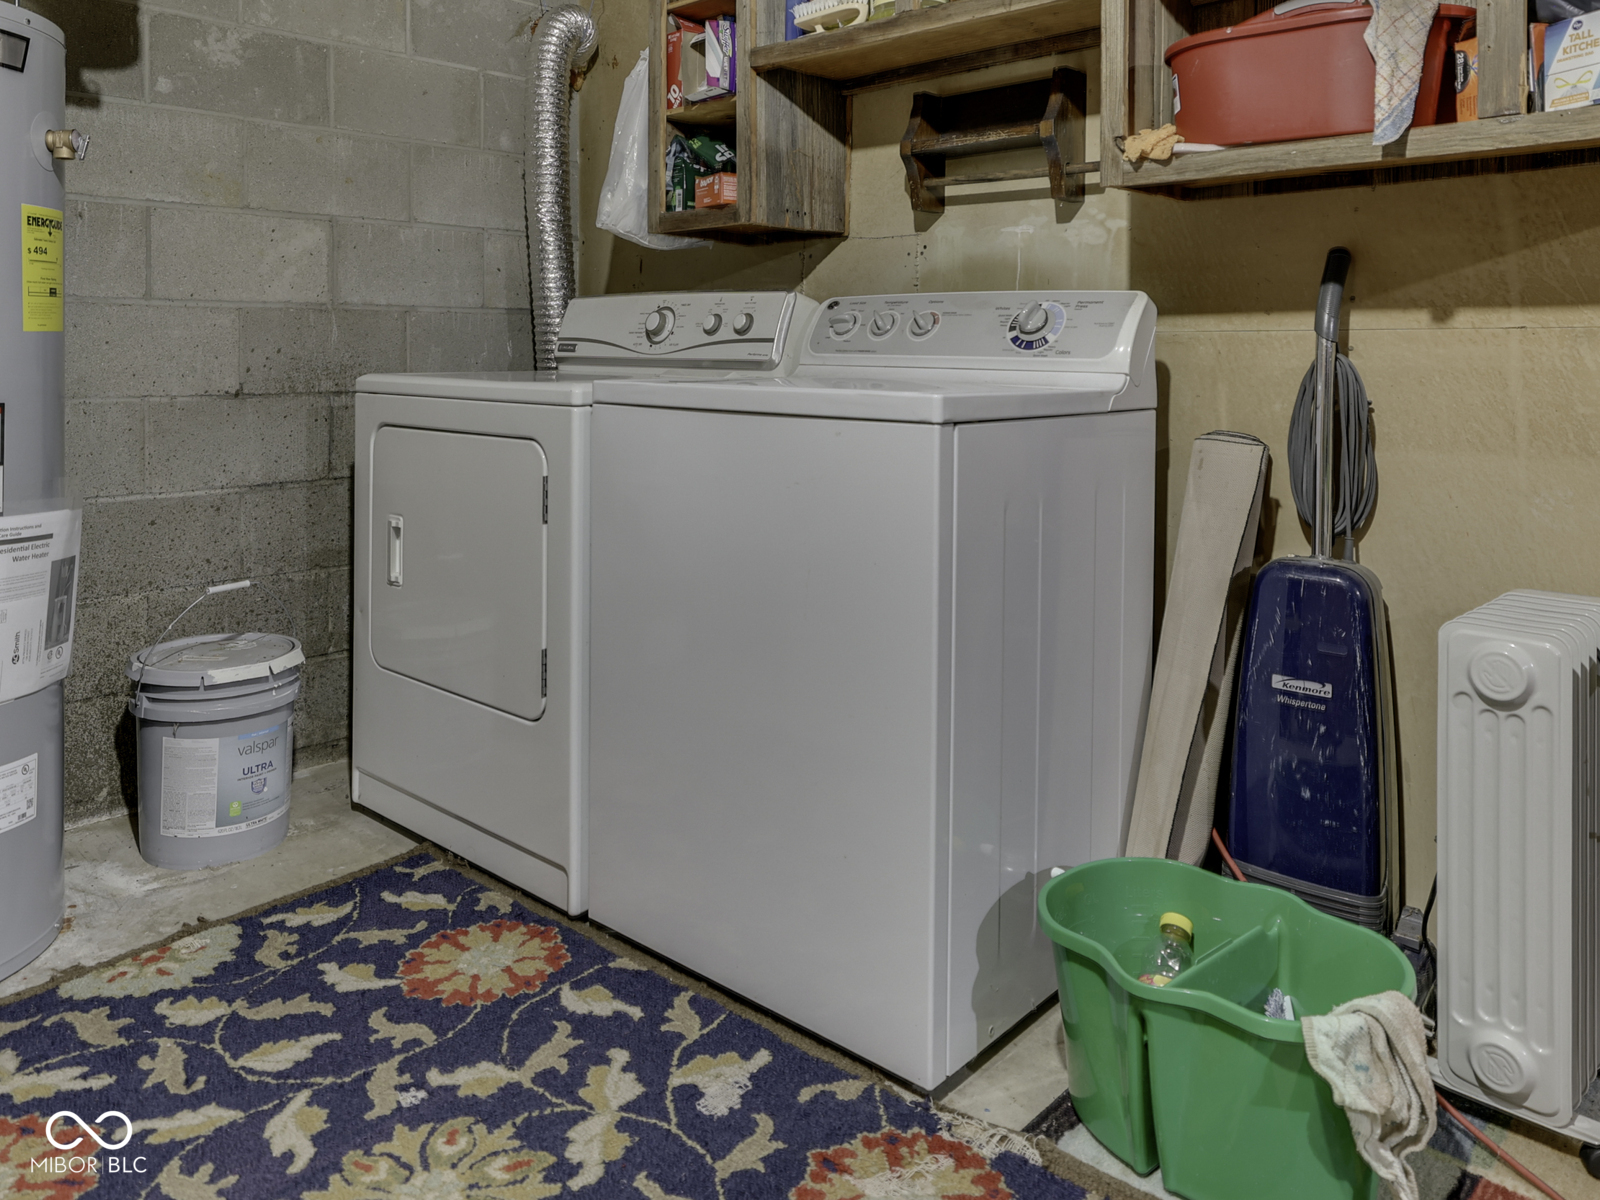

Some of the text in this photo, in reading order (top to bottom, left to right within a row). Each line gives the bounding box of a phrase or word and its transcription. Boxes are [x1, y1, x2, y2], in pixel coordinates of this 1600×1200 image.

[1568, 29, 1594, 43] TALL
[1457, 53, 1464, 64] 28
[12, 551, 50, 562] Water Heater
[1281, 682, 1331, 696] Kenmore
[1276, 694, 1327, 711] Whispertone
[237, 735, 280, 757] valspar
[242, 760, 274, 776] ULTRA
